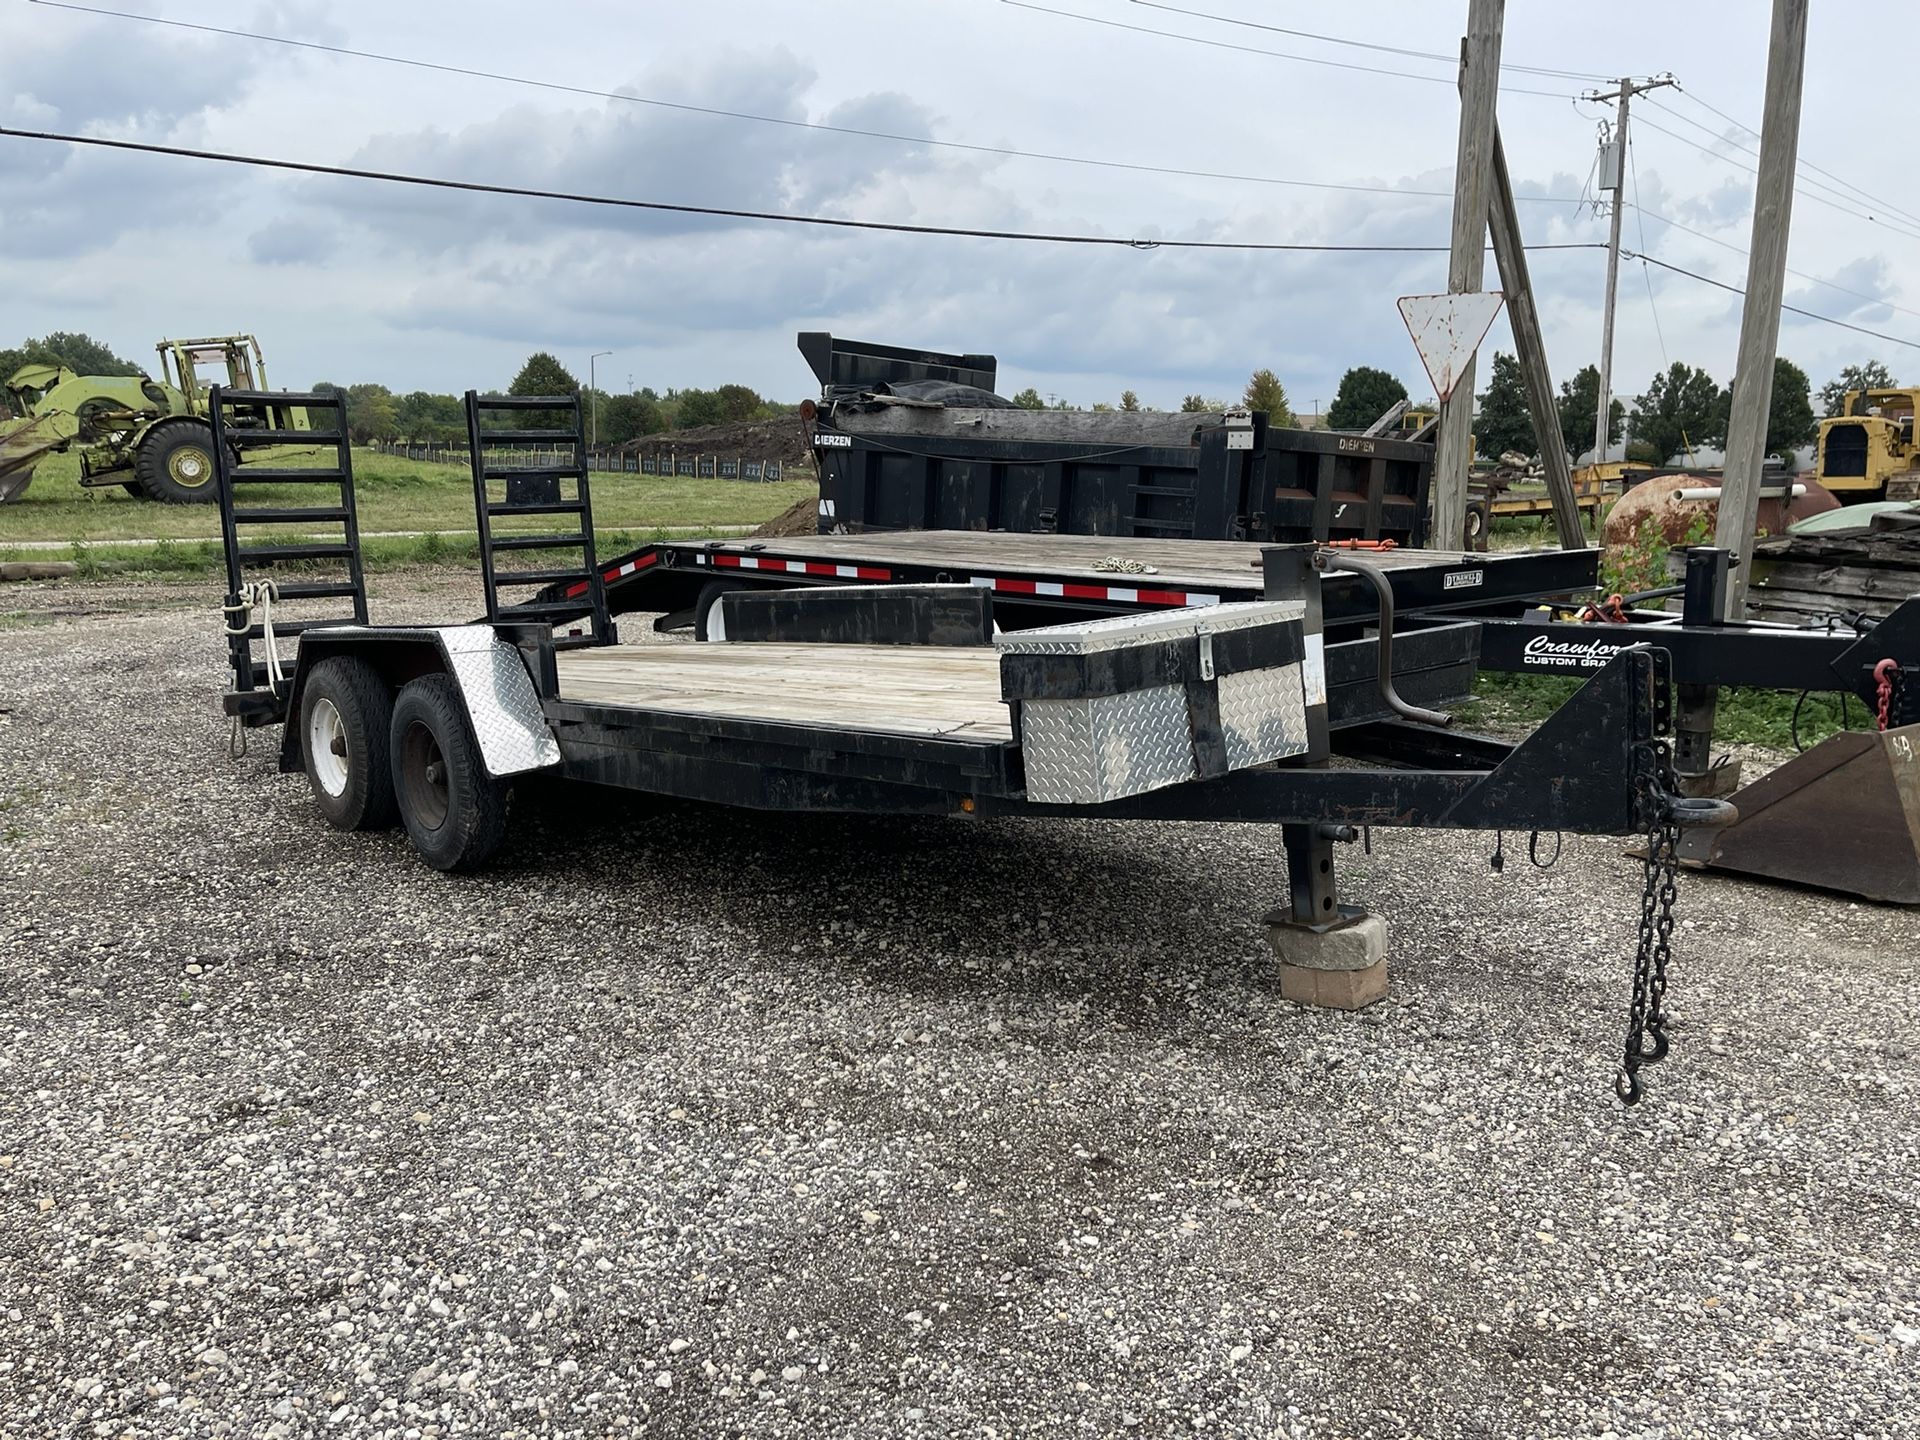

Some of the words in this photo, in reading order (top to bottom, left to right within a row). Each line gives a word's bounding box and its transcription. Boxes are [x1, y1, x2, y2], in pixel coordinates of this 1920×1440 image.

[814, 434, 852, 447] DIERZEN
[1524, 635, 1641, 659] Crawfor
[1524, 656, 1576, 666] CUSTOM
[1581, 658, 1608, 668] GRA
